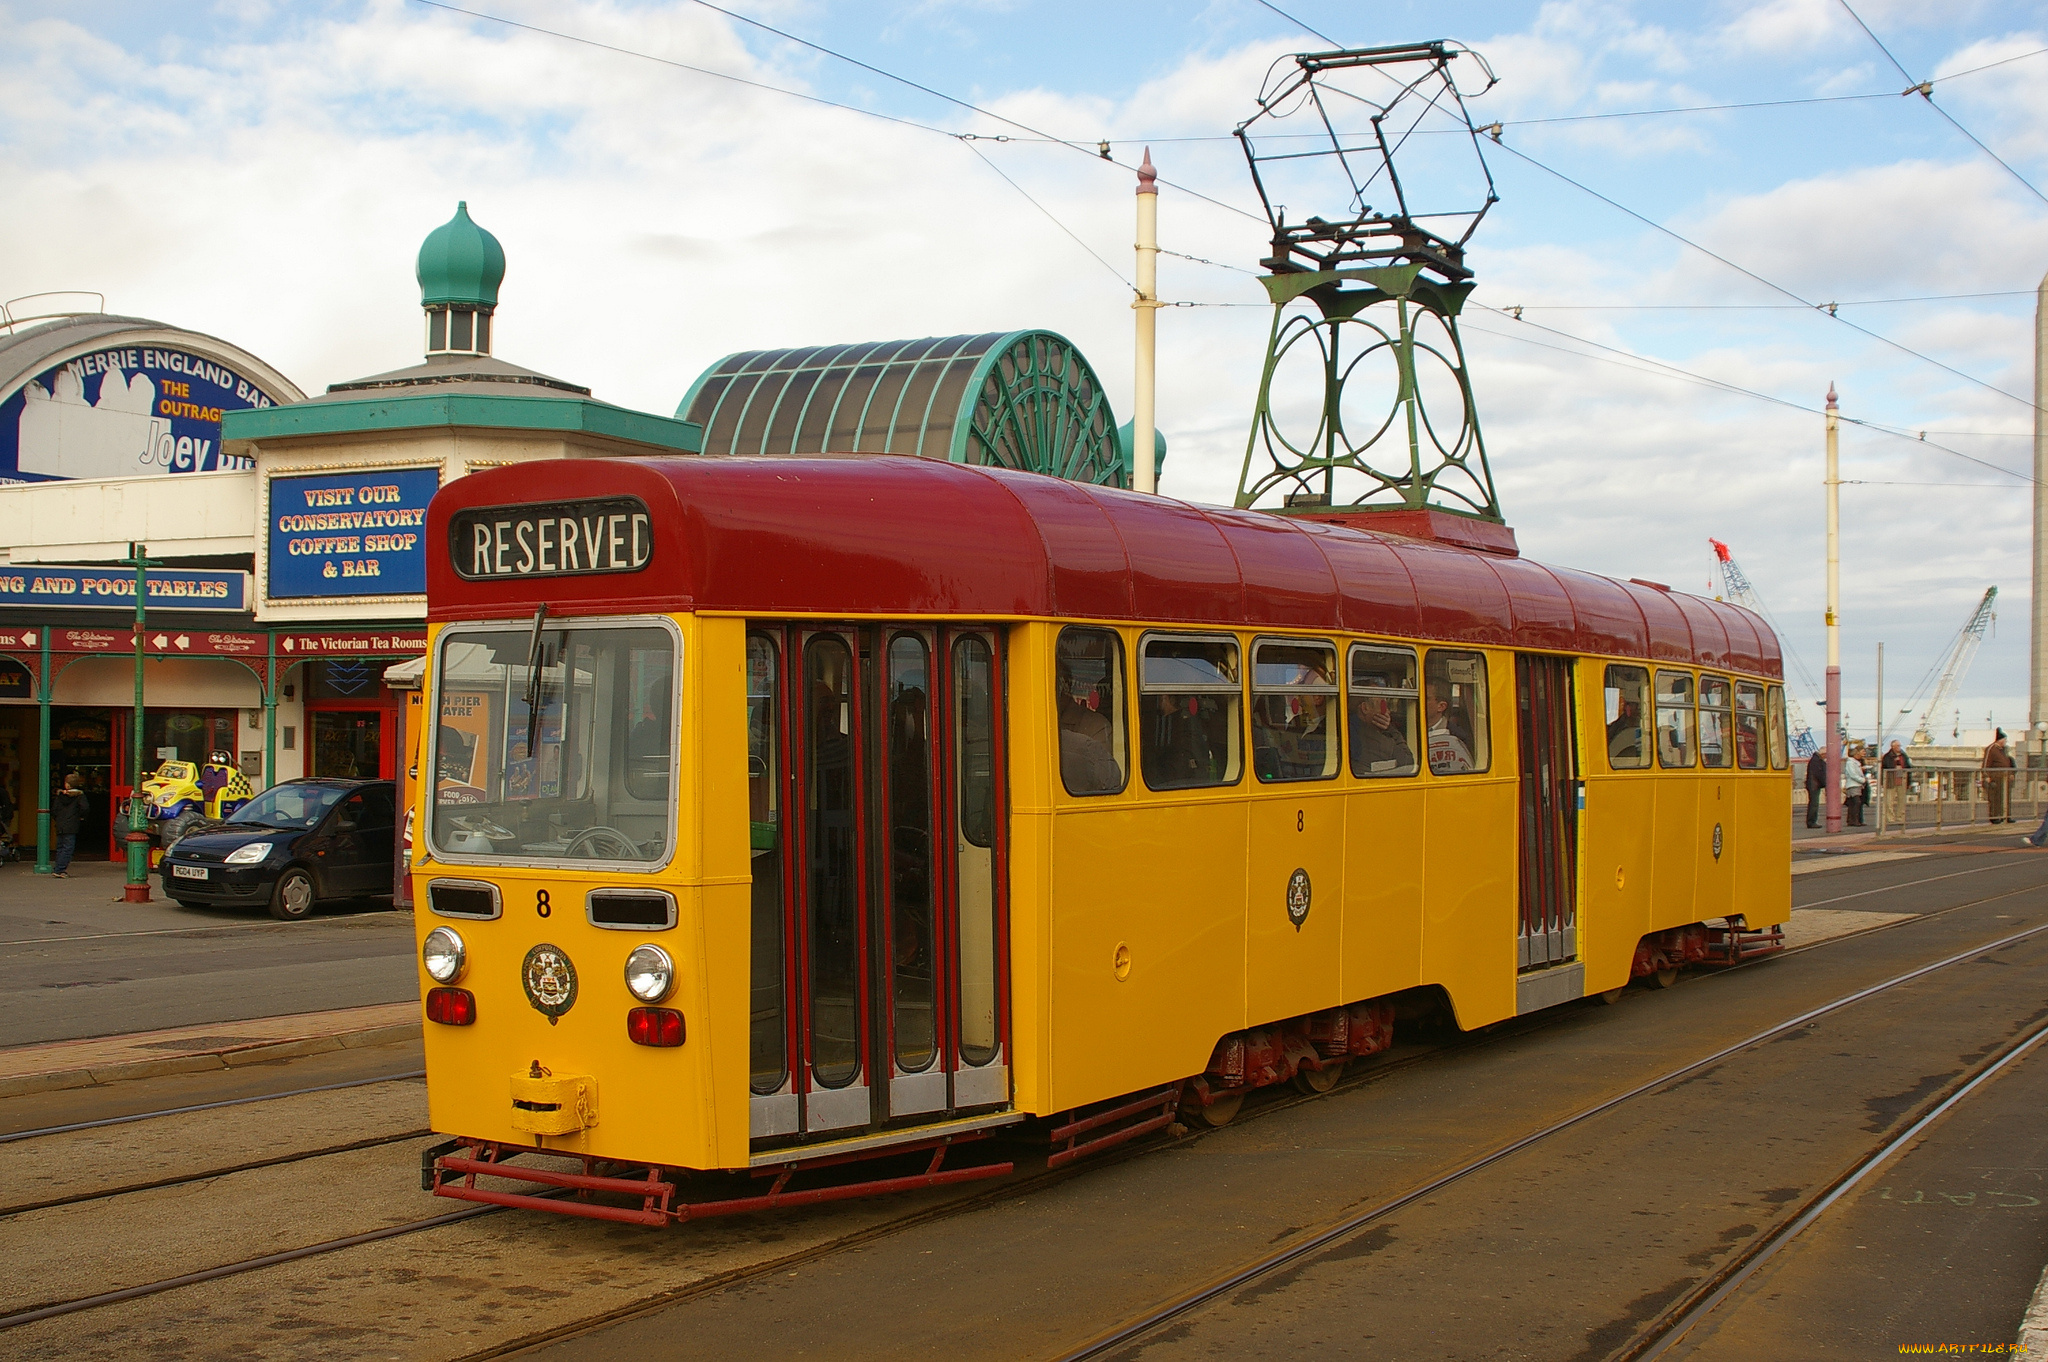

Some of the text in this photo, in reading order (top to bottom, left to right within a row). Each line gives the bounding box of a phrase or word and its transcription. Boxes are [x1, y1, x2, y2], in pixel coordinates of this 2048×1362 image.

[67, 350, 138, 378] MERRIE
[143, 350, 233, 389] ENGLAND
[161, 379, 190, 398] THE
[139, 420, 211, 472] Joey
[304, 485, 400, 507] VISIT OUR
[279, 508, 426, 532] CONSERVATORY
[289, 533, 417, 556] COFFEE SHOP
[473, 513, 650, 574] RESERVED
[322, 559, 381, 578] & BAR
[30, 577, 76, 594] AND
[146, 580, 229, 598] TABLES
[299, 636, 428, 650] The Victorian Tea Rooms
[454, 696, 481, 706] PIER
[1297, 809, 1304, 832] 8
[537, 889, 551, 918] 8
